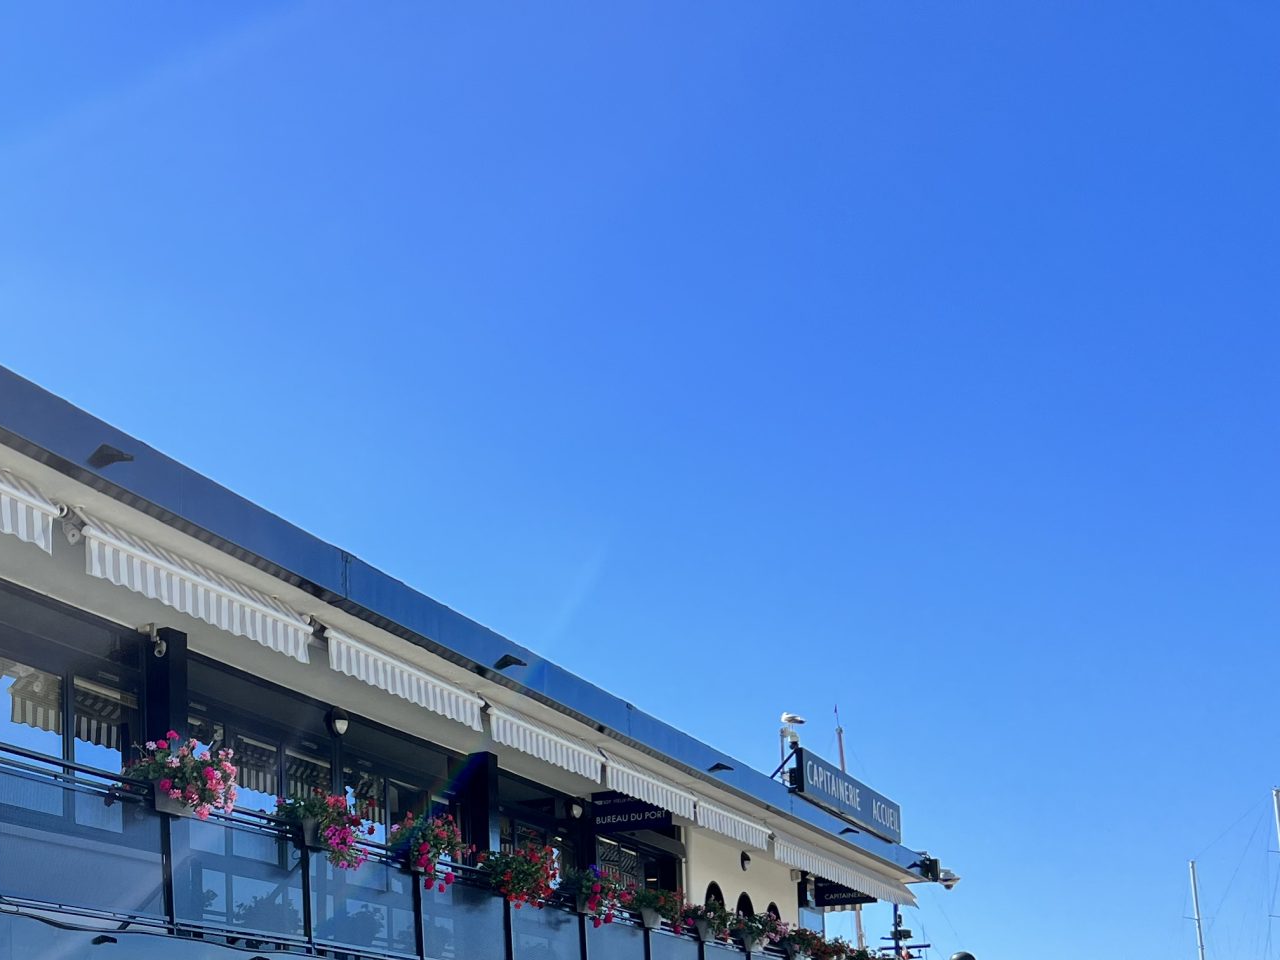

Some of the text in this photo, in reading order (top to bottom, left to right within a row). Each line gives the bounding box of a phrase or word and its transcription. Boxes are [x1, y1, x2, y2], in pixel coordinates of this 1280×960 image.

[595, 810, 666, 825] BUREAU DU PORT
[807, 760, 900, 833] CAPITAINERIE ACCUEIL
